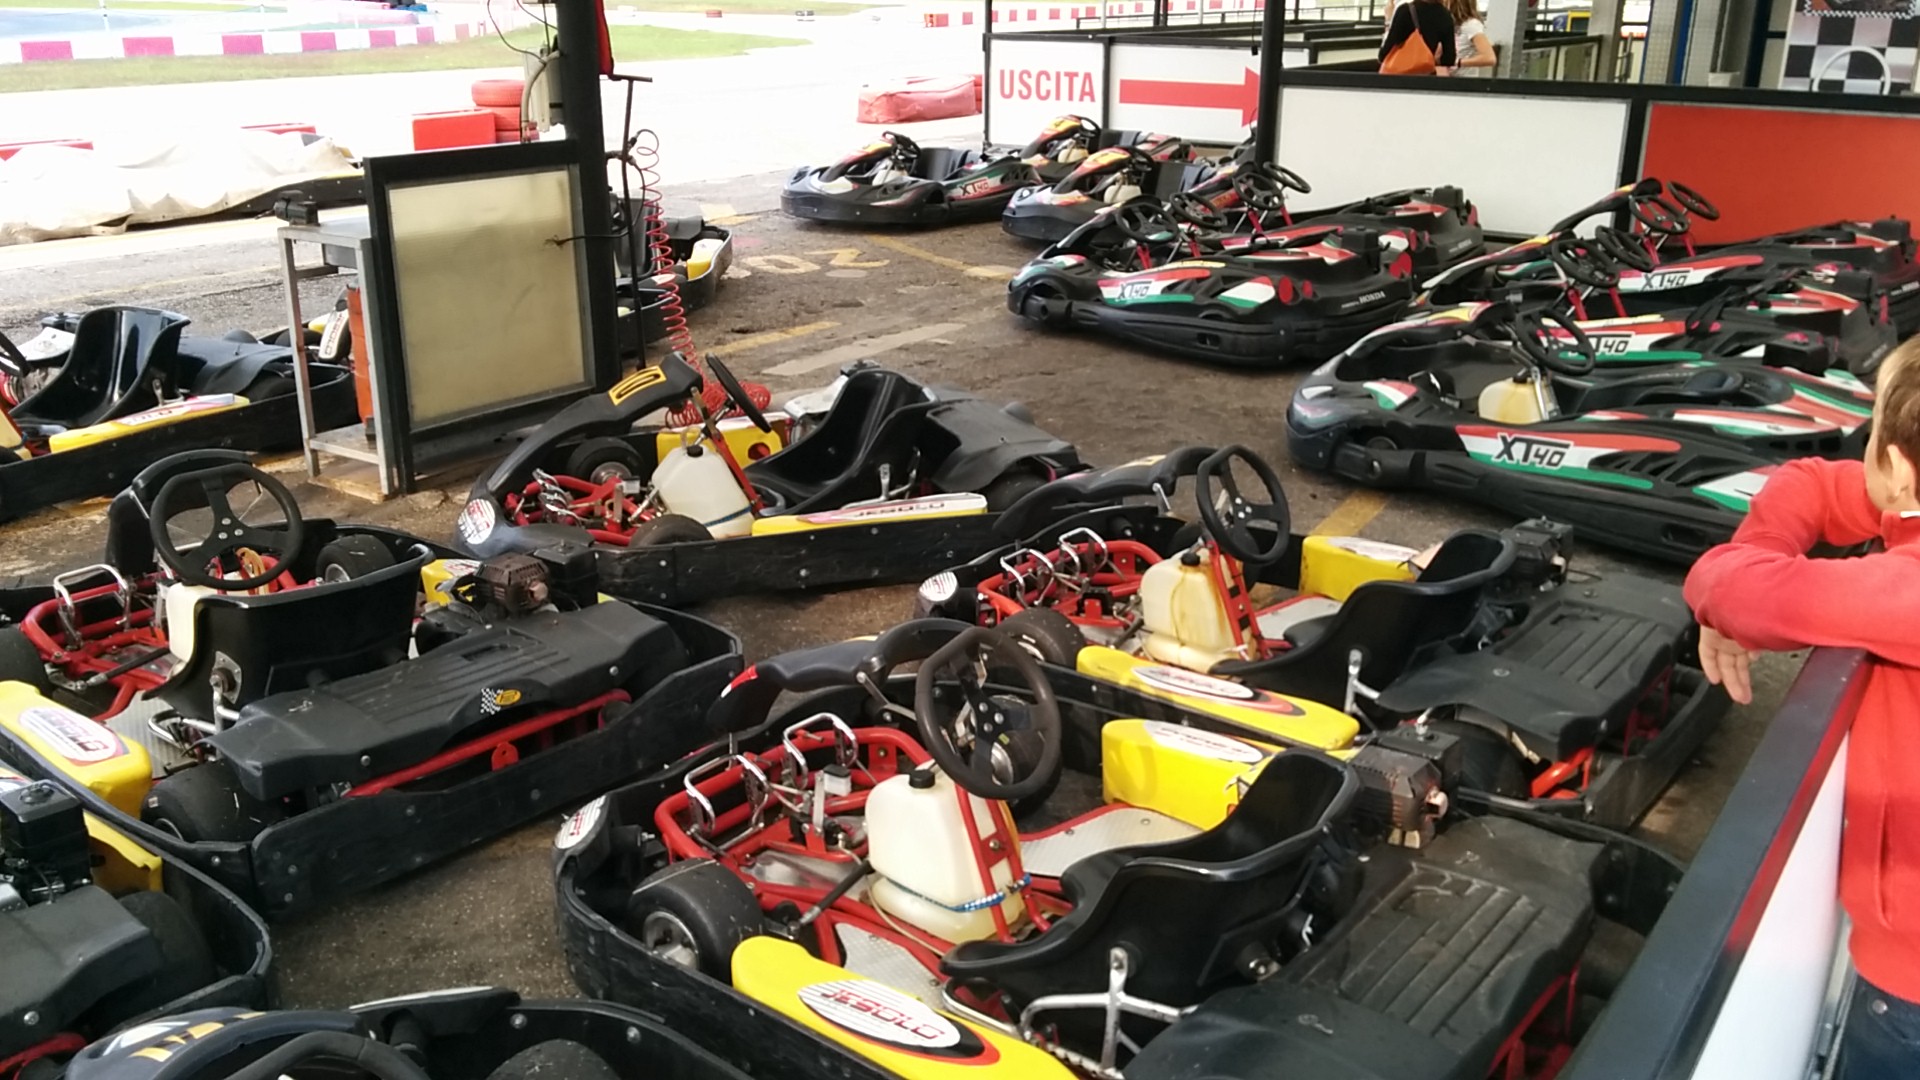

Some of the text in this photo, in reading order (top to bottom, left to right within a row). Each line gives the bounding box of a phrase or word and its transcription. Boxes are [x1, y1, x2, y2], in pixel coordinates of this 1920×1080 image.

[999, 69, 1096, 103] USCITA
[1117, 280, 1153, 300] XT40
[1641, 269, 1691, 292] XT40
[1358, 290, 1386, 304] HONDA
[1494, 434, 1571, 467] XT40
[820, 988, 946, 1040] JESOLO
